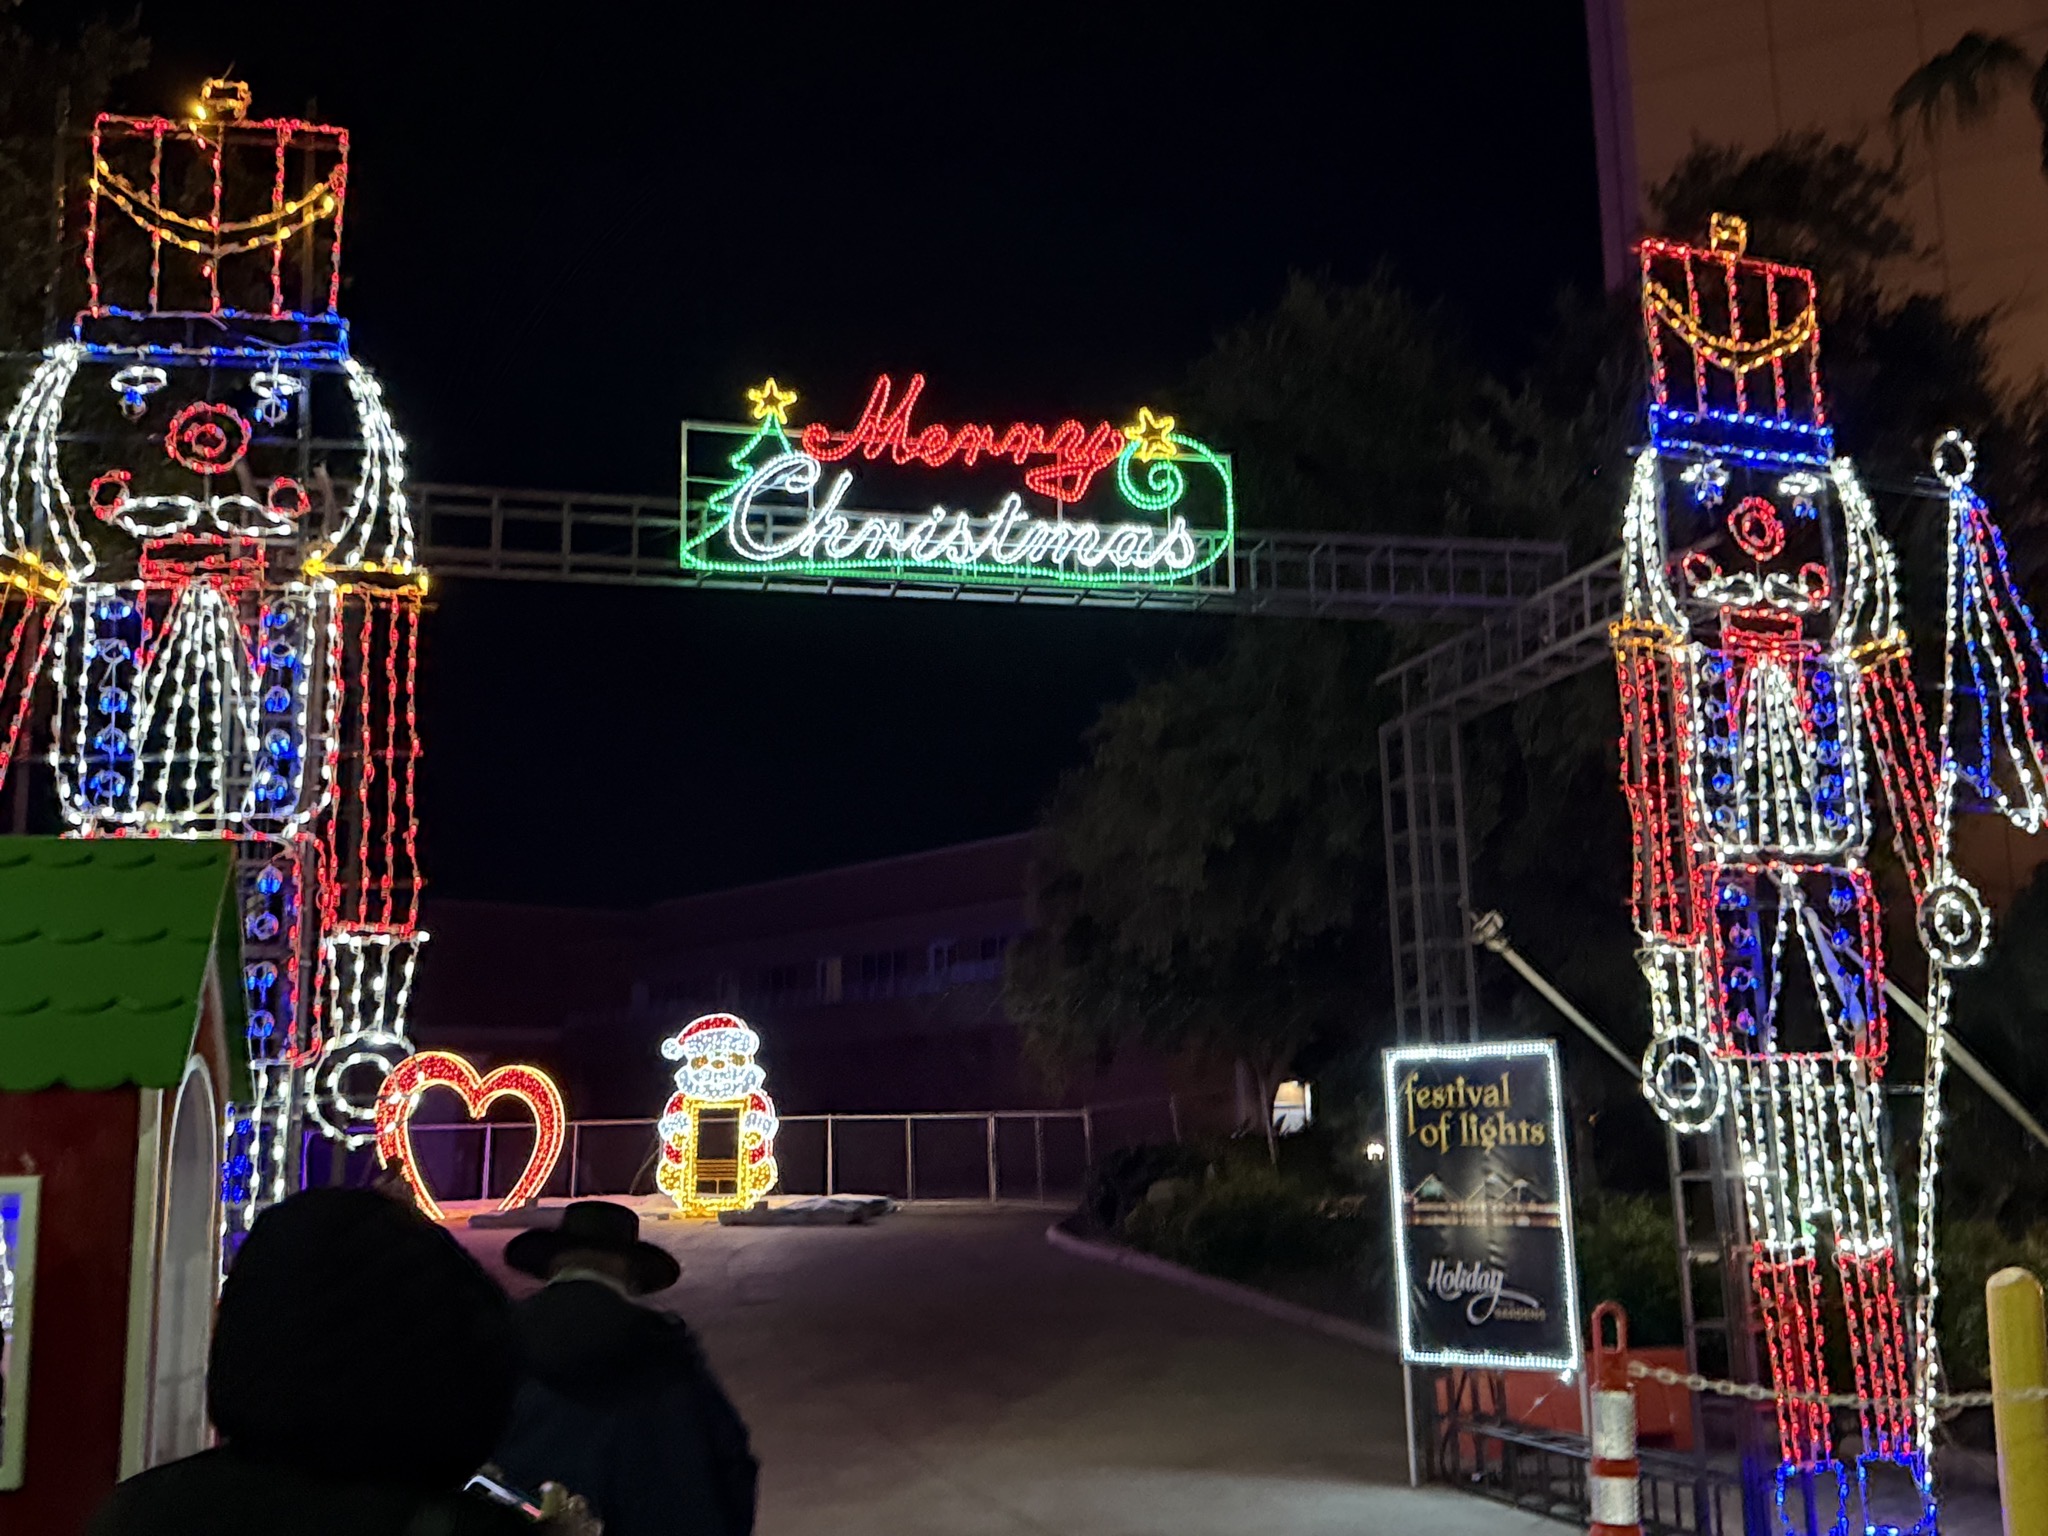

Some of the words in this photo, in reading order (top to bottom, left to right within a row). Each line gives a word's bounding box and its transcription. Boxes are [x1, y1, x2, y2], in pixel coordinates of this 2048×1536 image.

[802, 374, 1126, 503] Merry
[729, 453, 1194, 569] Christmas
[1405, 1072, 1510, 1136] festival
[1419, 1111, 1452, 1154] of
[1460, 1112, 1546, 1153] lights
[1427, 1260, 1539, 1325] Holiday
